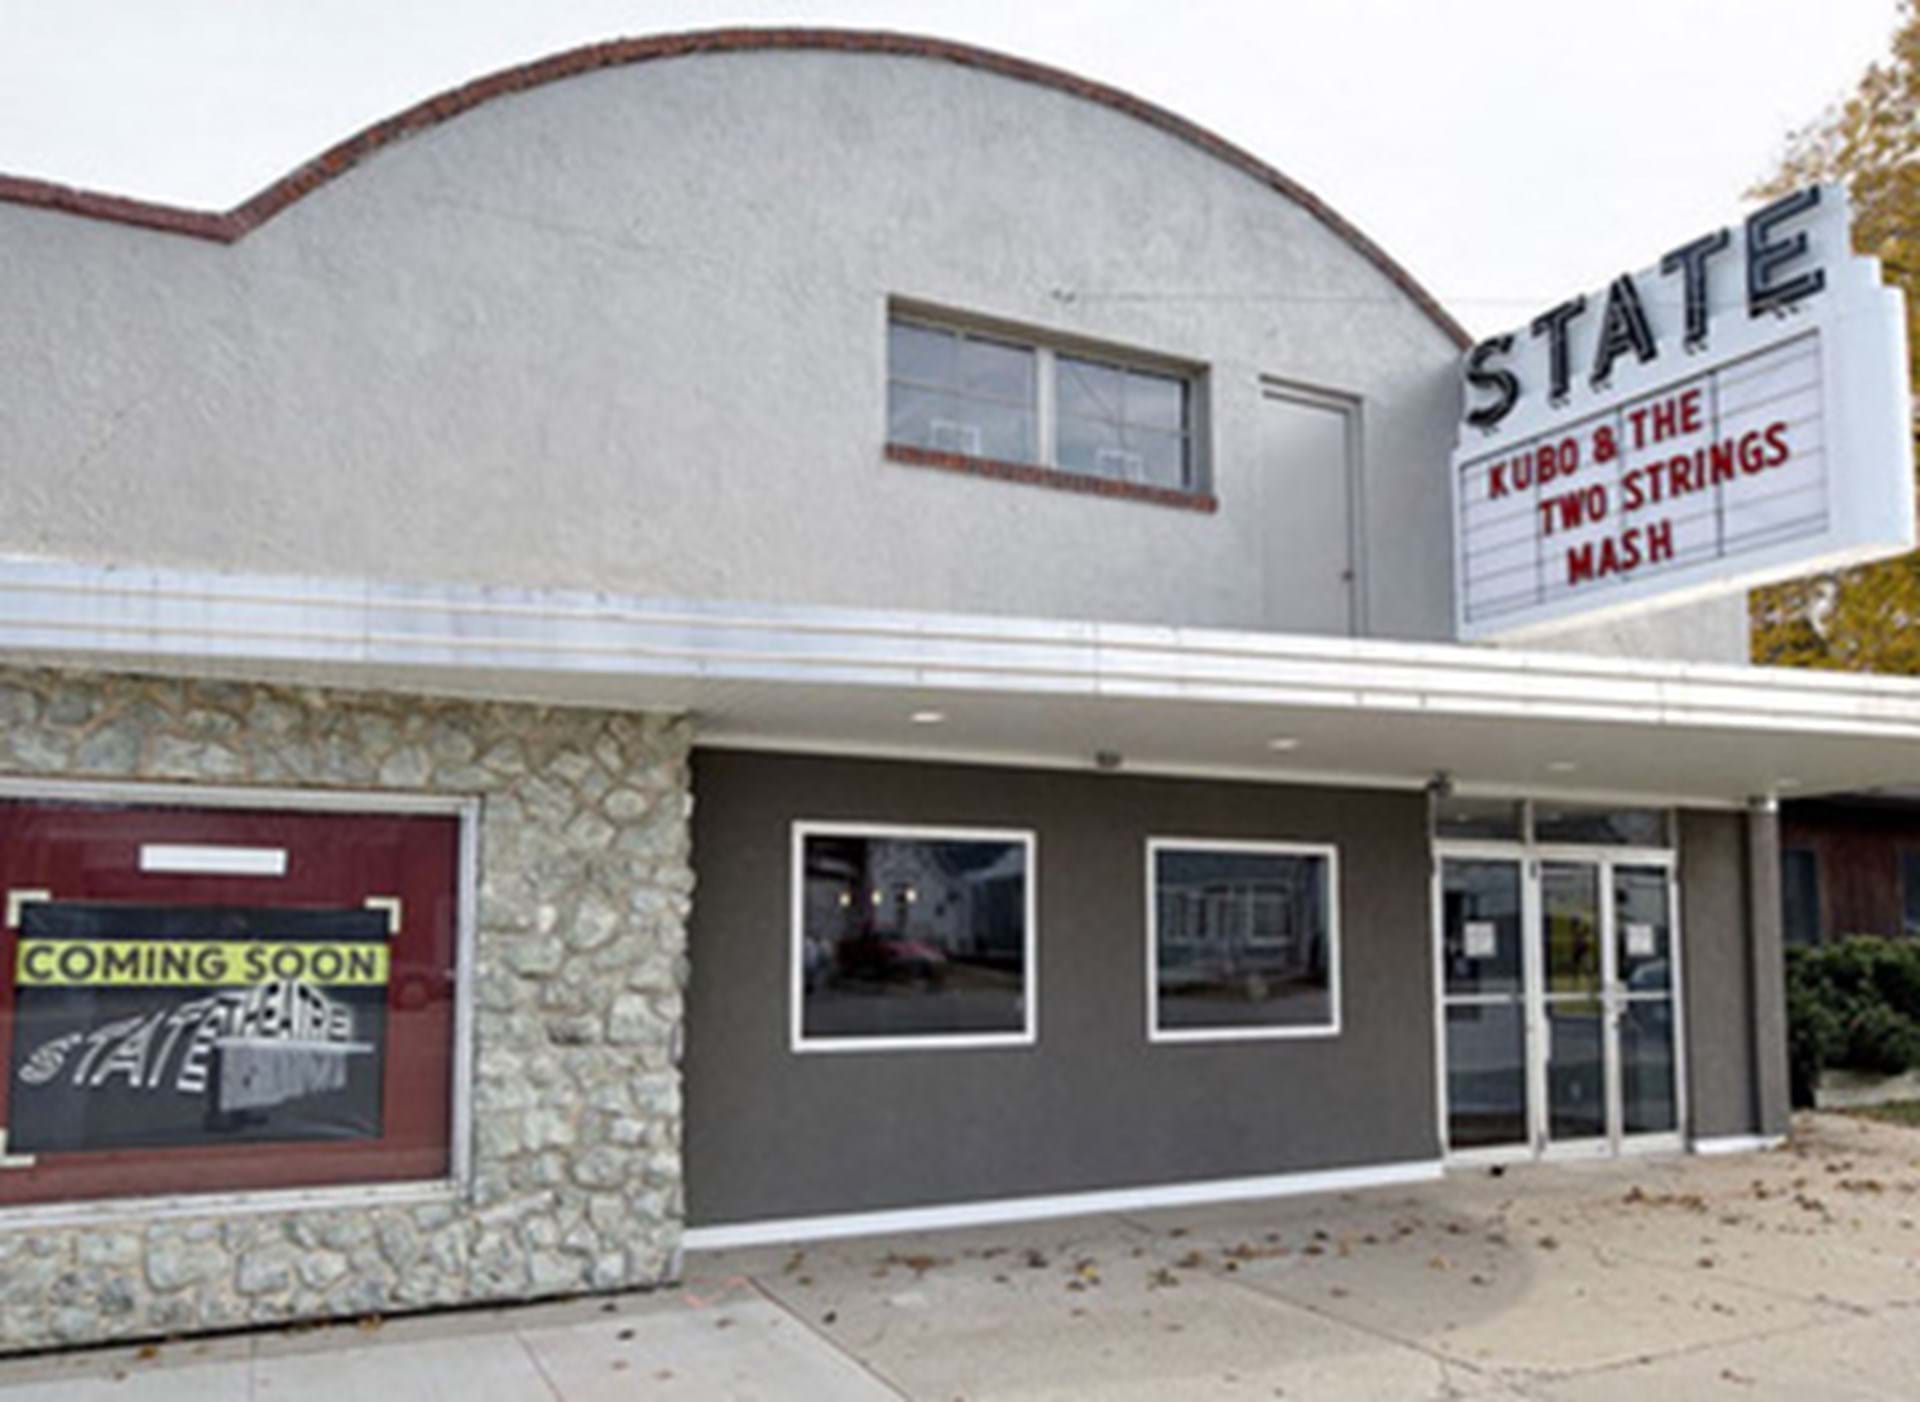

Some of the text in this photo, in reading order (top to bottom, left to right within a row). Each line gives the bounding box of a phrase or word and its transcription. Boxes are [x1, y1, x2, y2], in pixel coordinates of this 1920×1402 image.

[1466, 185, 1826, 428] STATE
[1488, 389, 1702, 499] KUBO & THE
[1538, 422, 1790, 536] TWO STRINGS
[1566, 520, 1674, 585] MASH
[23, 945, 376, 980] COMING SOON
[18, 1002, 226, 1093] STATE
